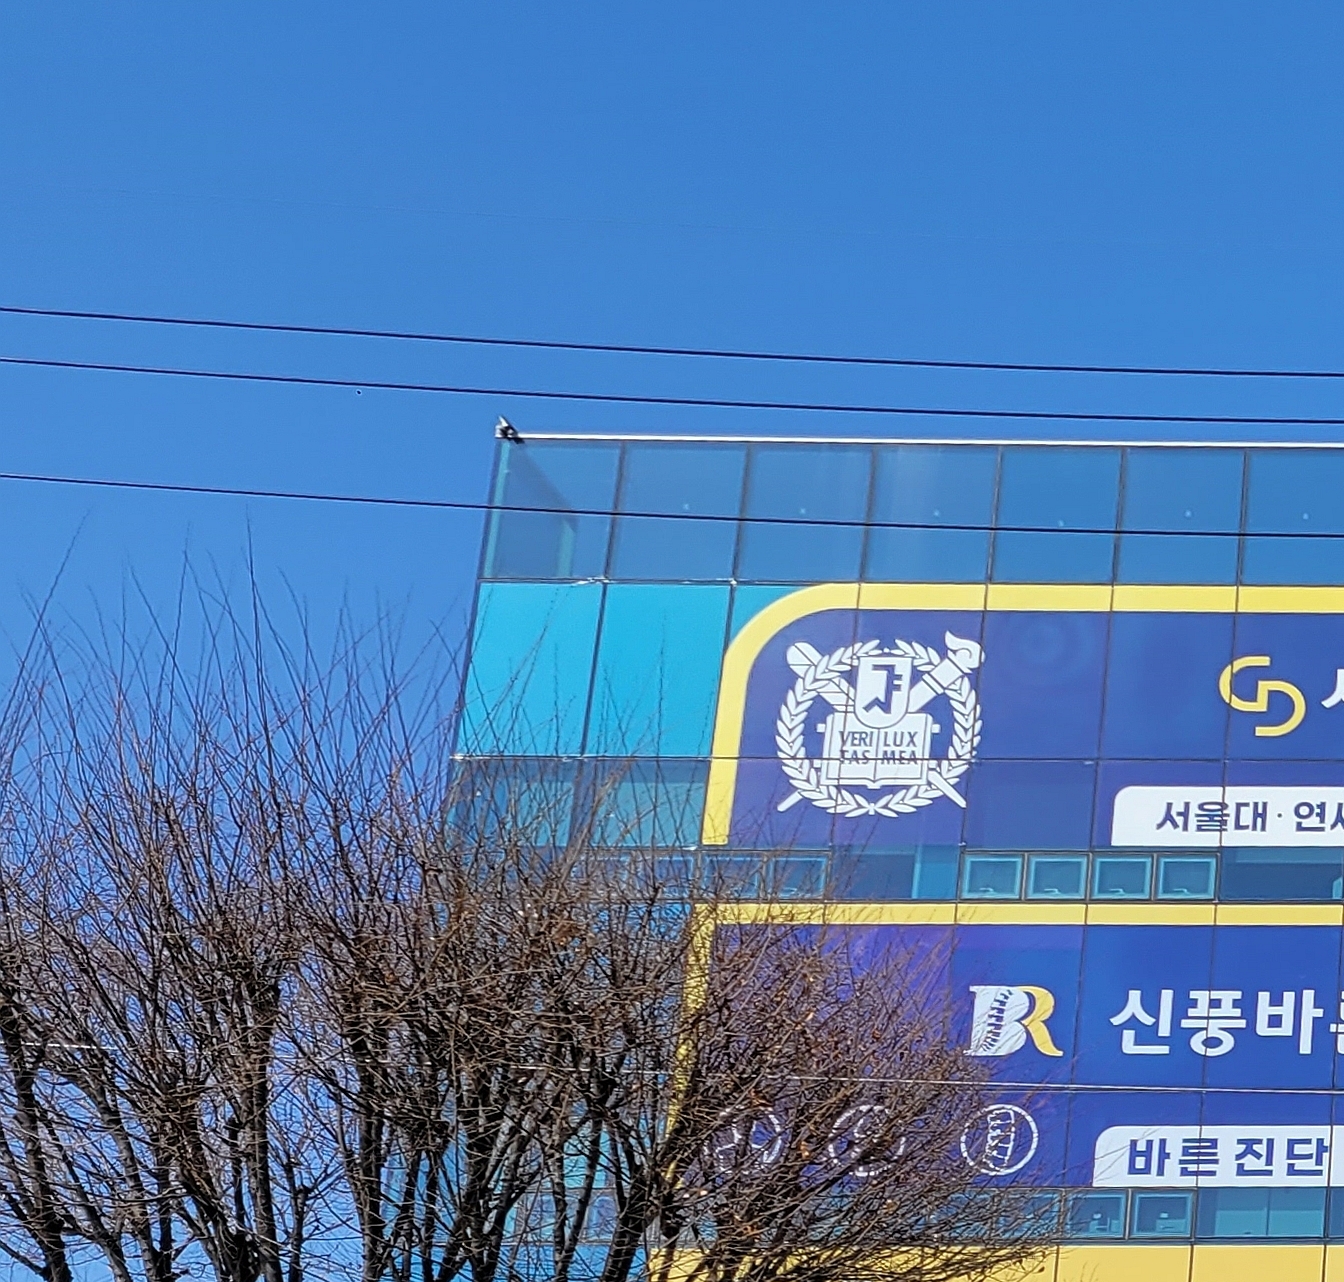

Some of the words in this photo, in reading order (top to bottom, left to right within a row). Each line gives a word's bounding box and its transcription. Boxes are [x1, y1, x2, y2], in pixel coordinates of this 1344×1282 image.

[838, 731, 873, 748] VERI
[883, 731, 919, 748] LUX
[839, 749, 871, 765] TAS
[880, 749, 919, 765] MEA
